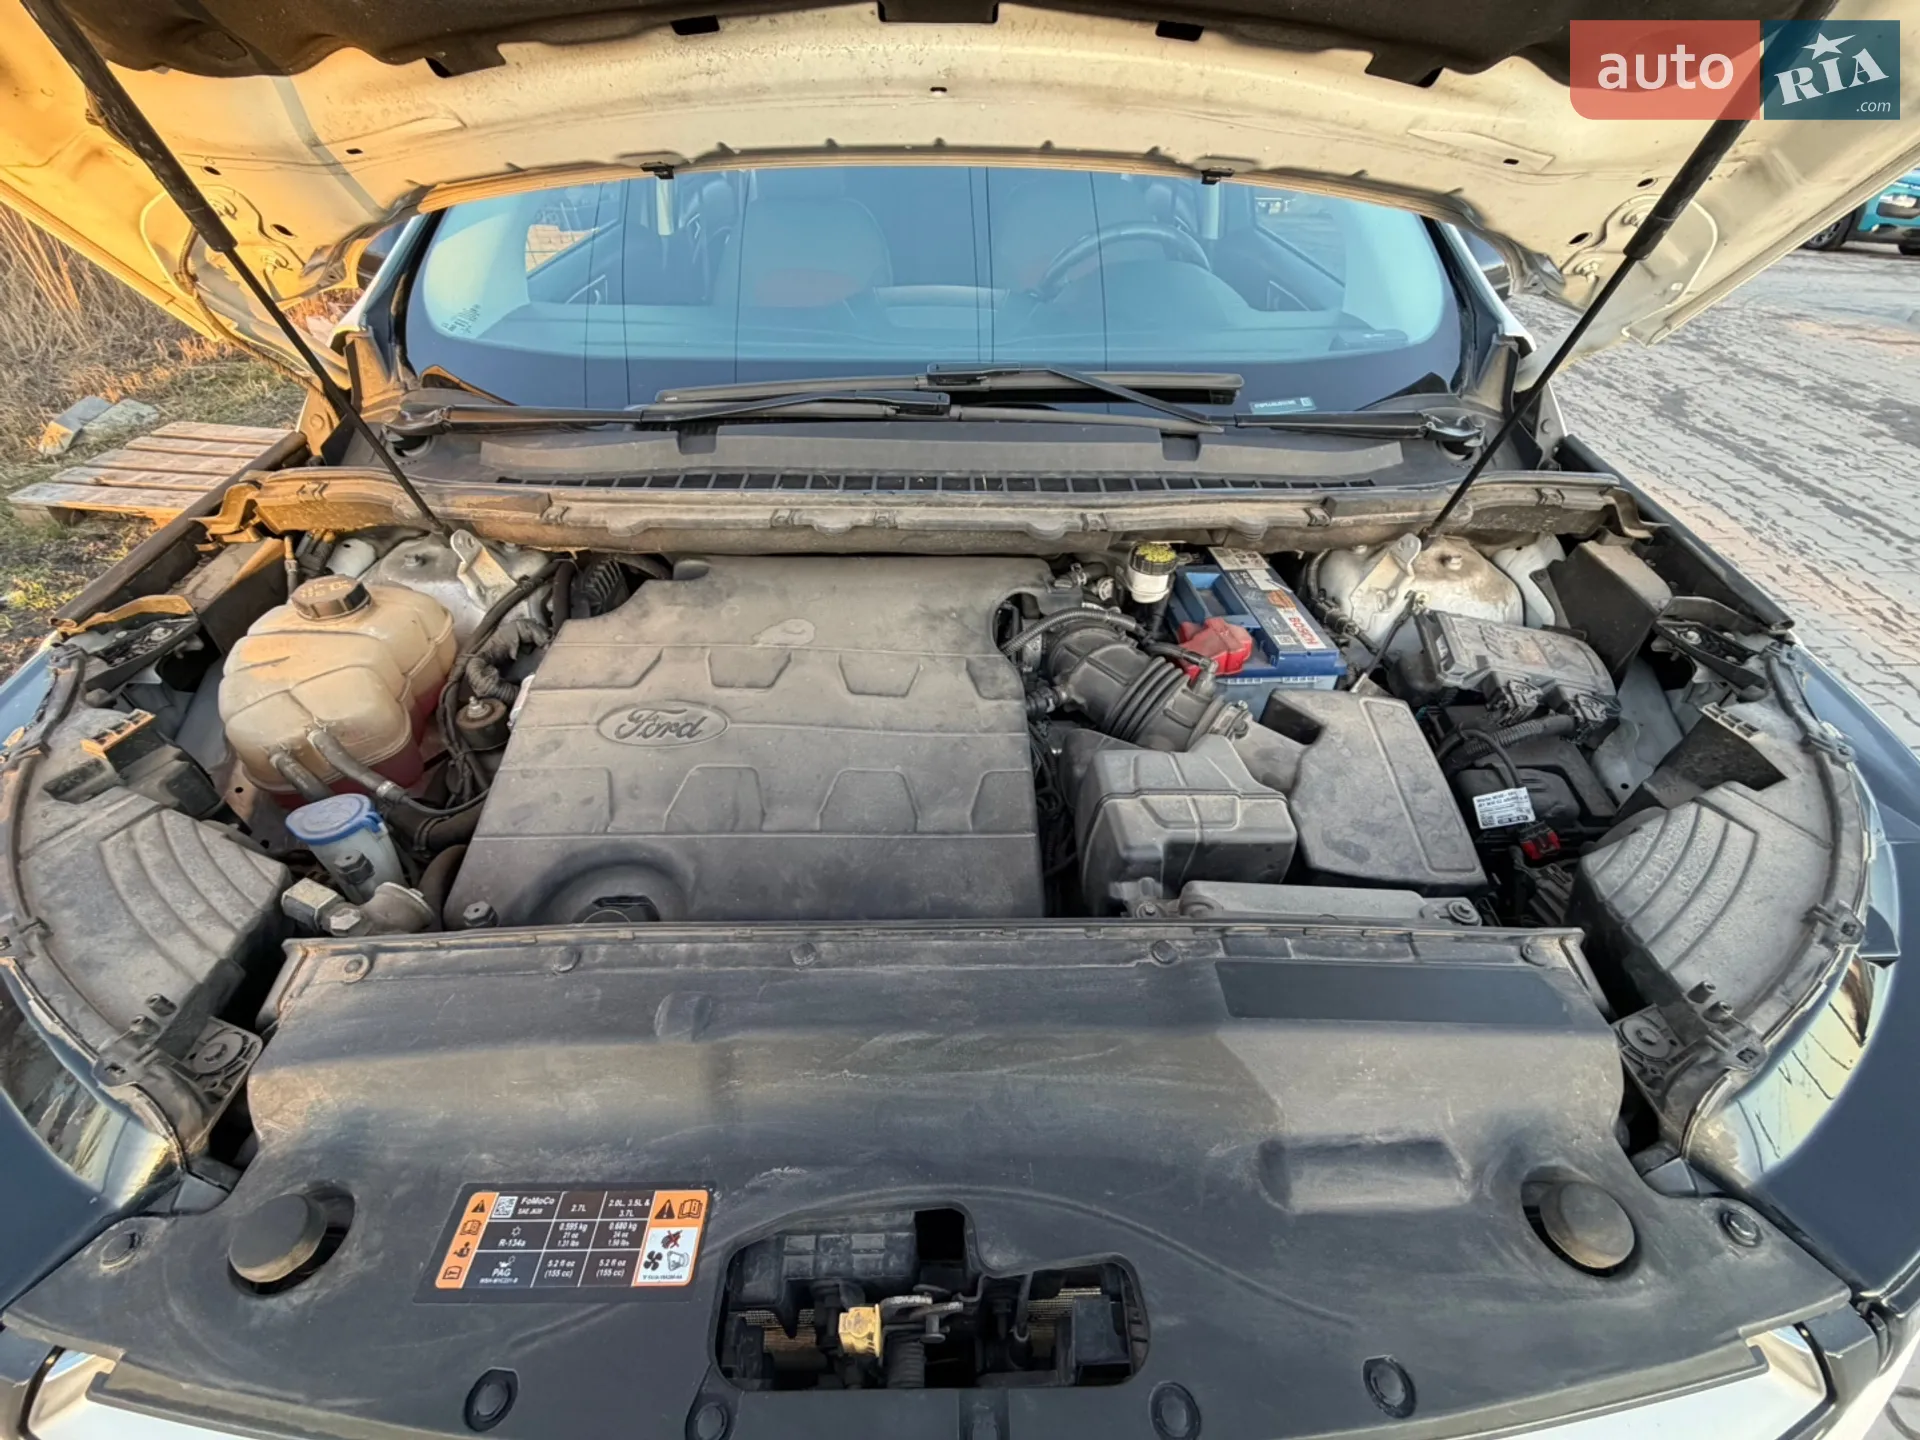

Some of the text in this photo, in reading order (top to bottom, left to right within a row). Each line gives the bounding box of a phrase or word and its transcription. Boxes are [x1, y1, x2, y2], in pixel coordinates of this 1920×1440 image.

[1288, 616, 1319, 644] BOSCH
[614, 708, 708, 739] Ford
[521, 1196, 555, 1205] FoMoCo
[571, 1204, 586, 1212] 2.7L
[579, 1222, 588, 1232] kg
[628, 1221, 638, 1232] kg
[498, 1239, 526, 1247] R-134a
[492, 1268, 511, 1277] PAG
[544, 1269, 573, 1278] (155 cc)
[596, 1269, 625, 1278] (155 cc)
